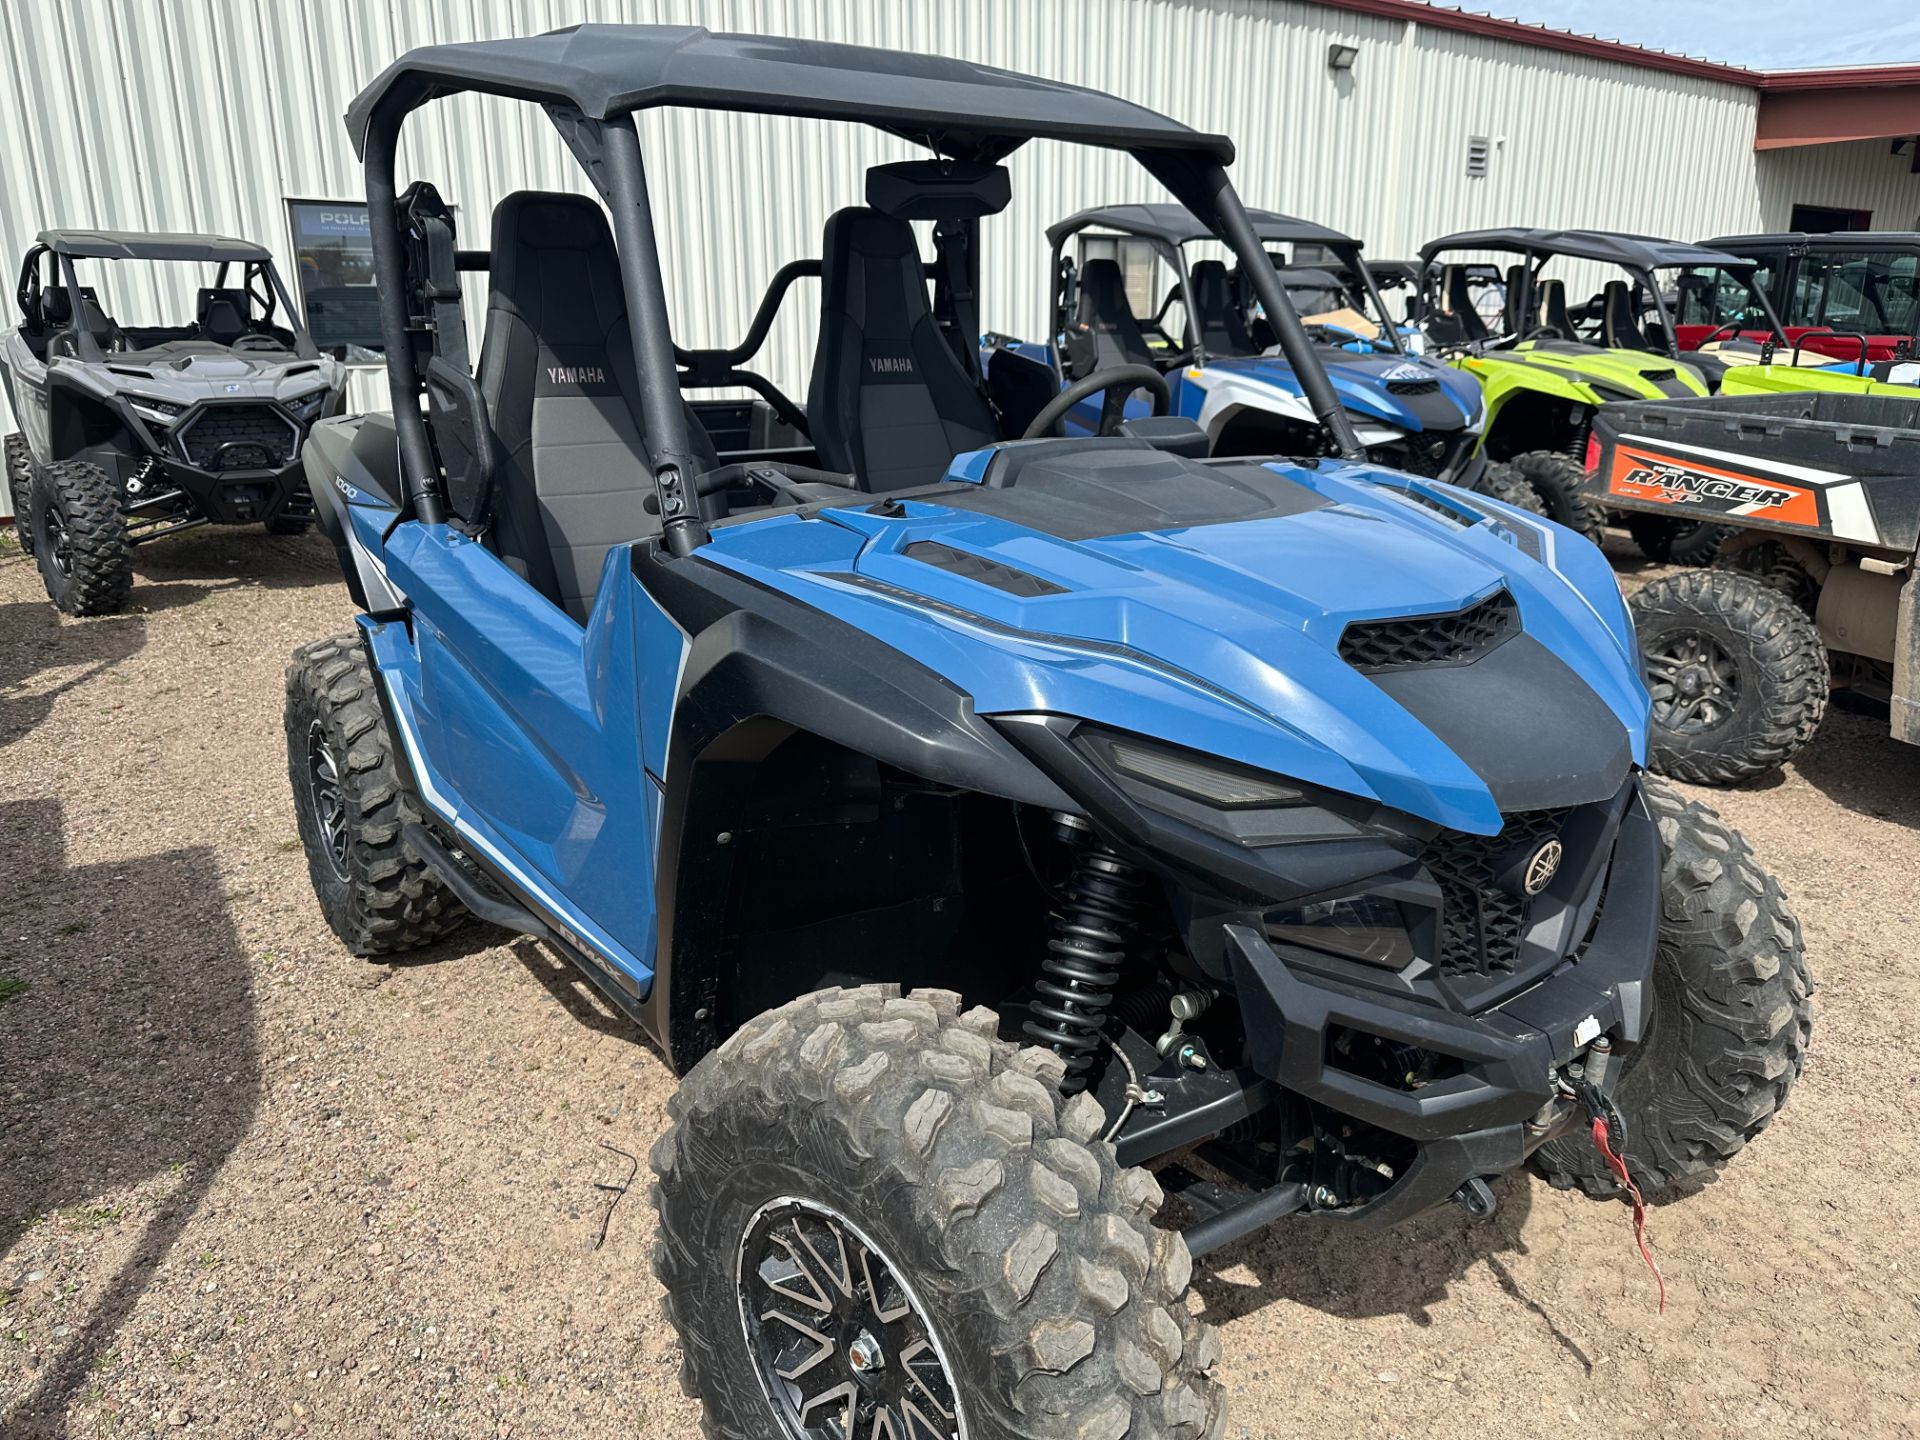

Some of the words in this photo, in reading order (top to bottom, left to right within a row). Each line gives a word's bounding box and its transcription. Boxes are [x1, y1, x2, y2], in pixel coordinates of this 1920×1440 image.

[869, 358, 913, 373] YAMAHA
[547, 367, 606, 384] YAMAHA
[335, 475, 357, 499] 1000
[1622, 467, 1792, 507] RANGER
[1654, 489, 1704, 503] XP
